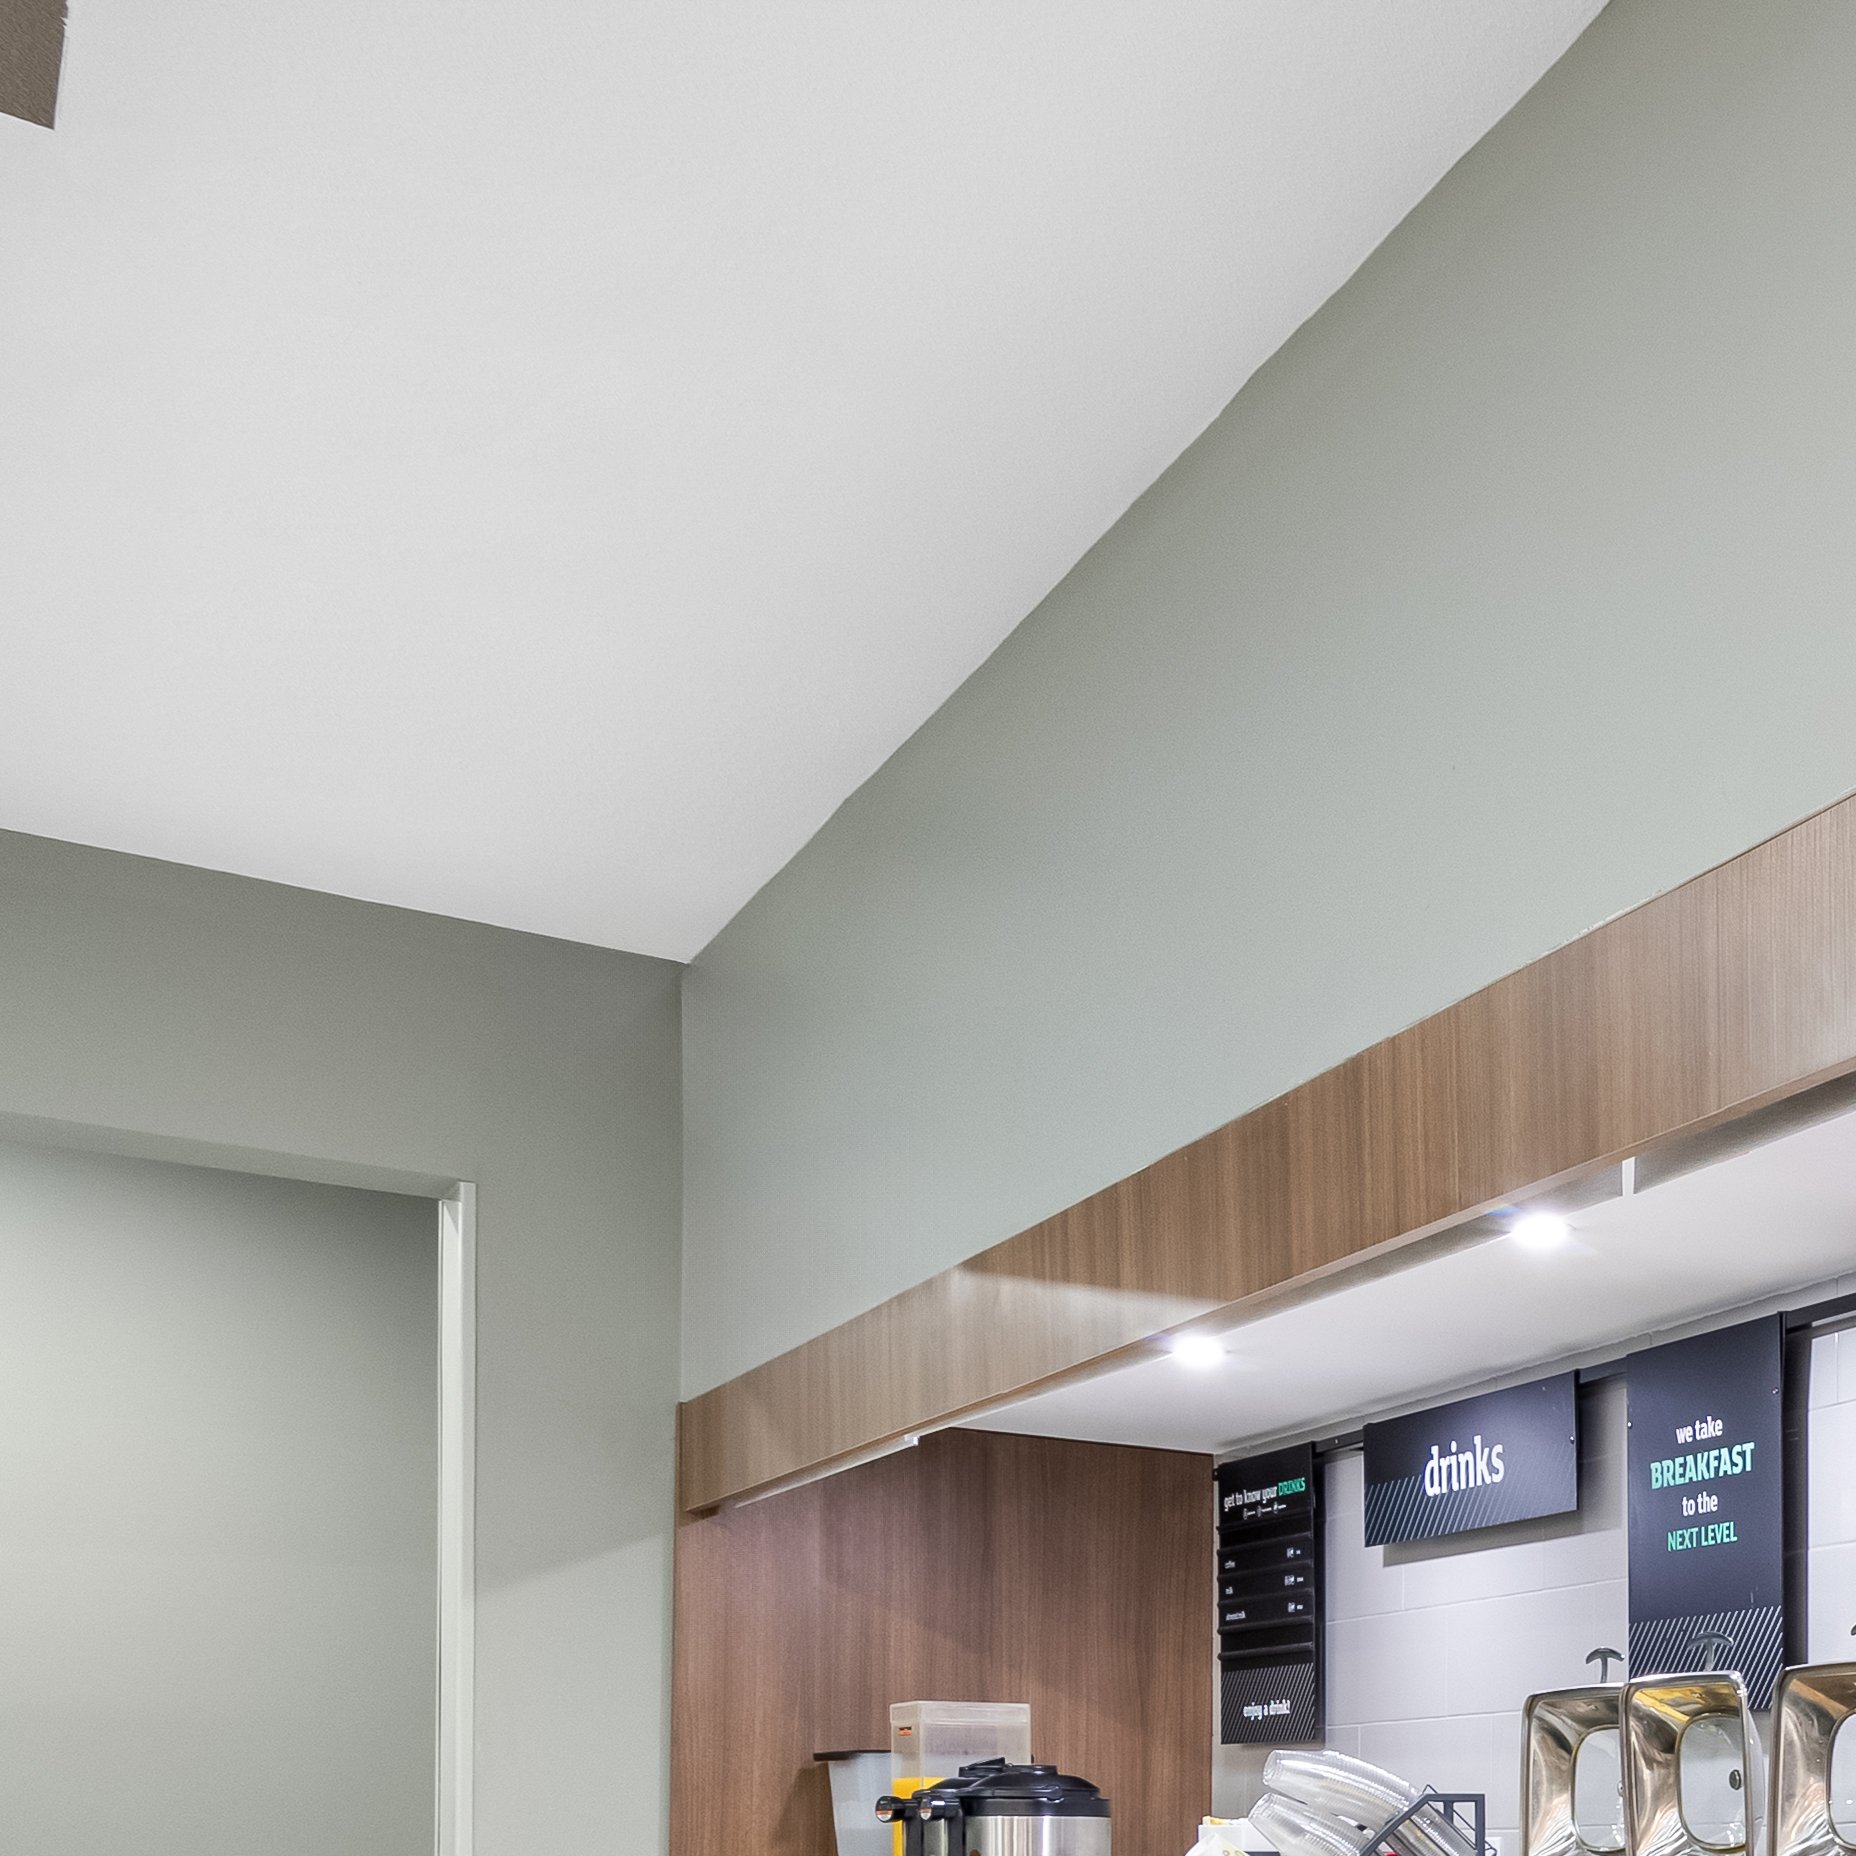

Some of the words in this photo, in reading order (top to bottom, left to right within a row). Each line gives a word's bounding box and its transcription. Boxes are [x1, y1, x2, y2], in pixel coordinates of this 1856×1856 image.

[1676, 1426, 1694, 1444] we
[1695, 1415, 1723, 1441] take
[1423, 1435, 1505, 1497] drinks
[1650, 1442, 1755, 1489] BREAKFAST
[1244, 1489, 1261, 1504] know
[1262, 1486, 1278, 1504] your
[1278, 1477, 1306, 1496] DRINKS
[1682, 1497, 1696, 1516] to
[1697, 1491, 1718, 1514] the
[1667, 1530, 1697, 1552] NEXT
[1701, 1521, 1738, 1547] LEVEL
